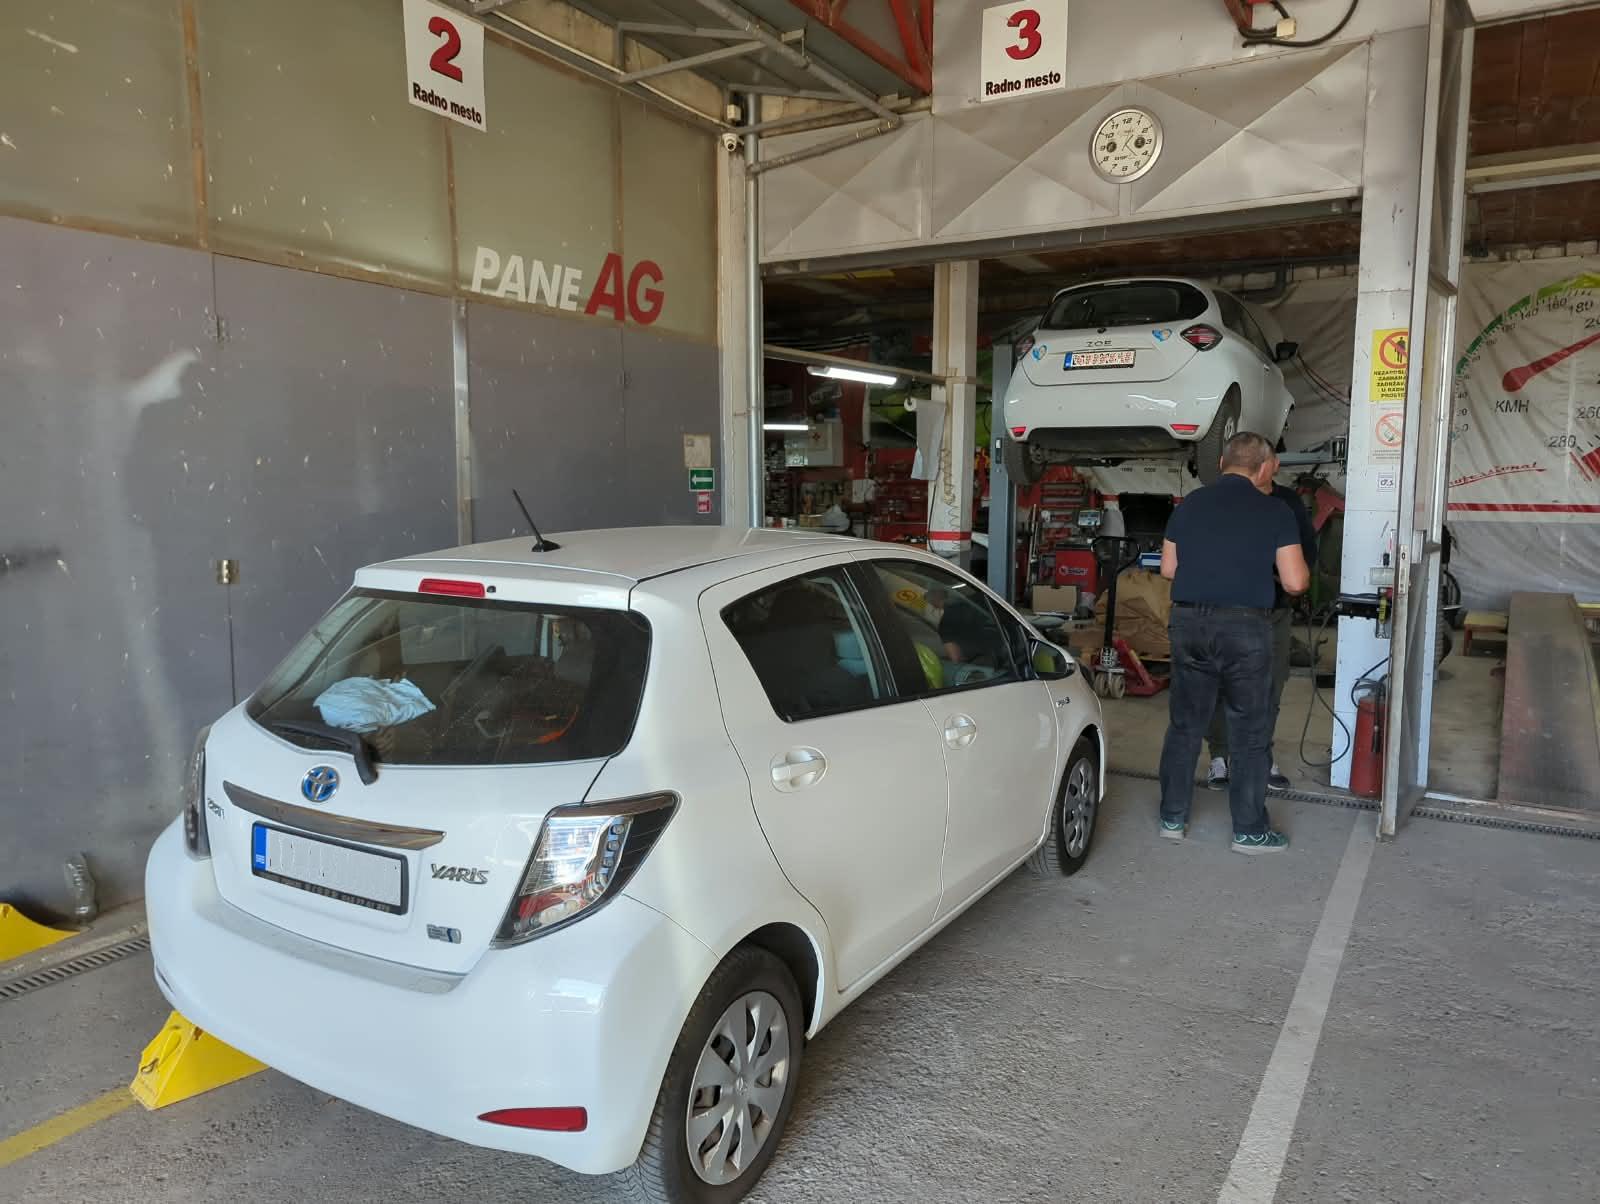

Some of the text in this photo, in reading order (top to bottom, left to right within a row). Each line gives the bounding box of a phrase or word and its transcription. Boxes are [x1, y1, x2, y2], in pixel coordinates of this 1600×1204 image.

[1005, 9, 1042, 60] 3
[428, 16, 463, 83] 2
[985, 70, 1061, 96] Radno mesto
[413, 82, 482, 125] Radno mesto
[471, 246, 665, 326] PANE AG
[1569, 300, 1594, 315] 180
[1085, 340, 1113, 348] ZOE
[1495, 399, 1530, 413] KMH
[1548, 434, 1577, 449] 280
[431, 863, 490, 885] YARIS
